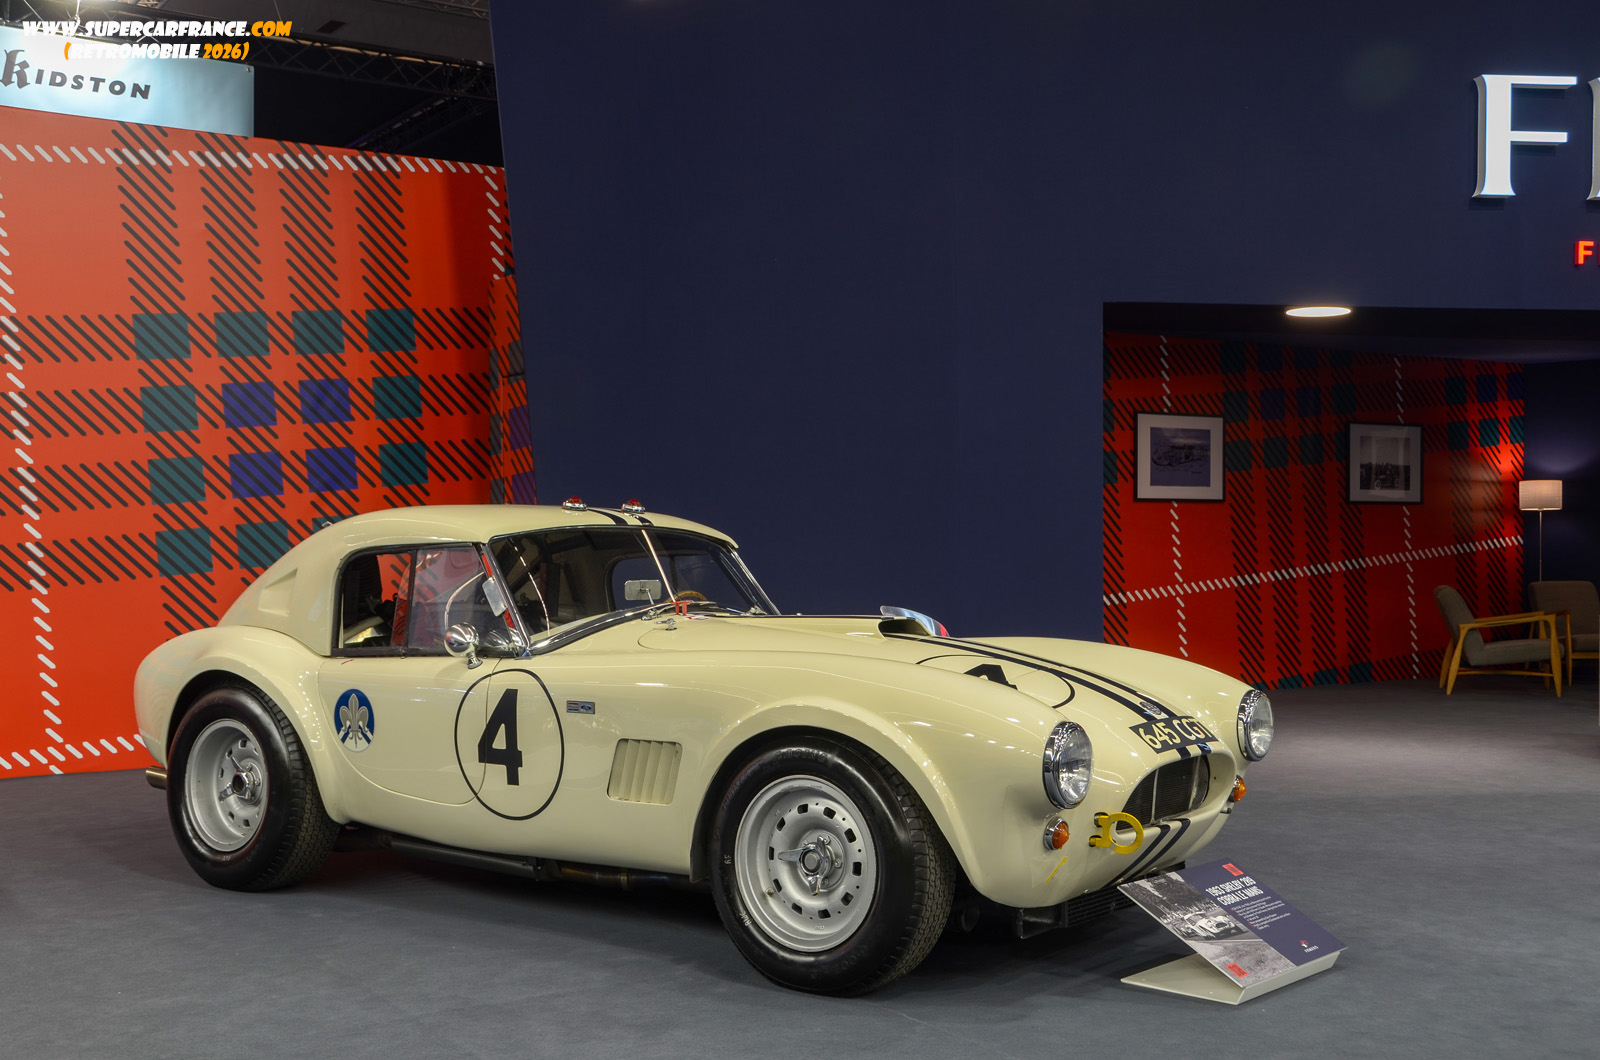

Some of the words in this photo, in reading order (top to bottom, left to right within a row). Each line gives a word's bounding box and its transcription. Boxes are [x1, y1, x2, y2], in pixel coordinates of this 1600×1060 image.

[1472, 74, 1600, 201] F
[1574, 240, 1600, 266] F
[477, 688, 523, 786] 4
[1138, 722, 1181, 749] 645
[1172, 718, 1212, 741] CGT
[1204, 886, 1226, 897] 1963
[1218, 880, 1244, 893] SHELBY
[1216, 893, 1241, 905] COBRA
[1236, 890, 1249, 900] LE
[1243, 886, 1264, 897] MANS
